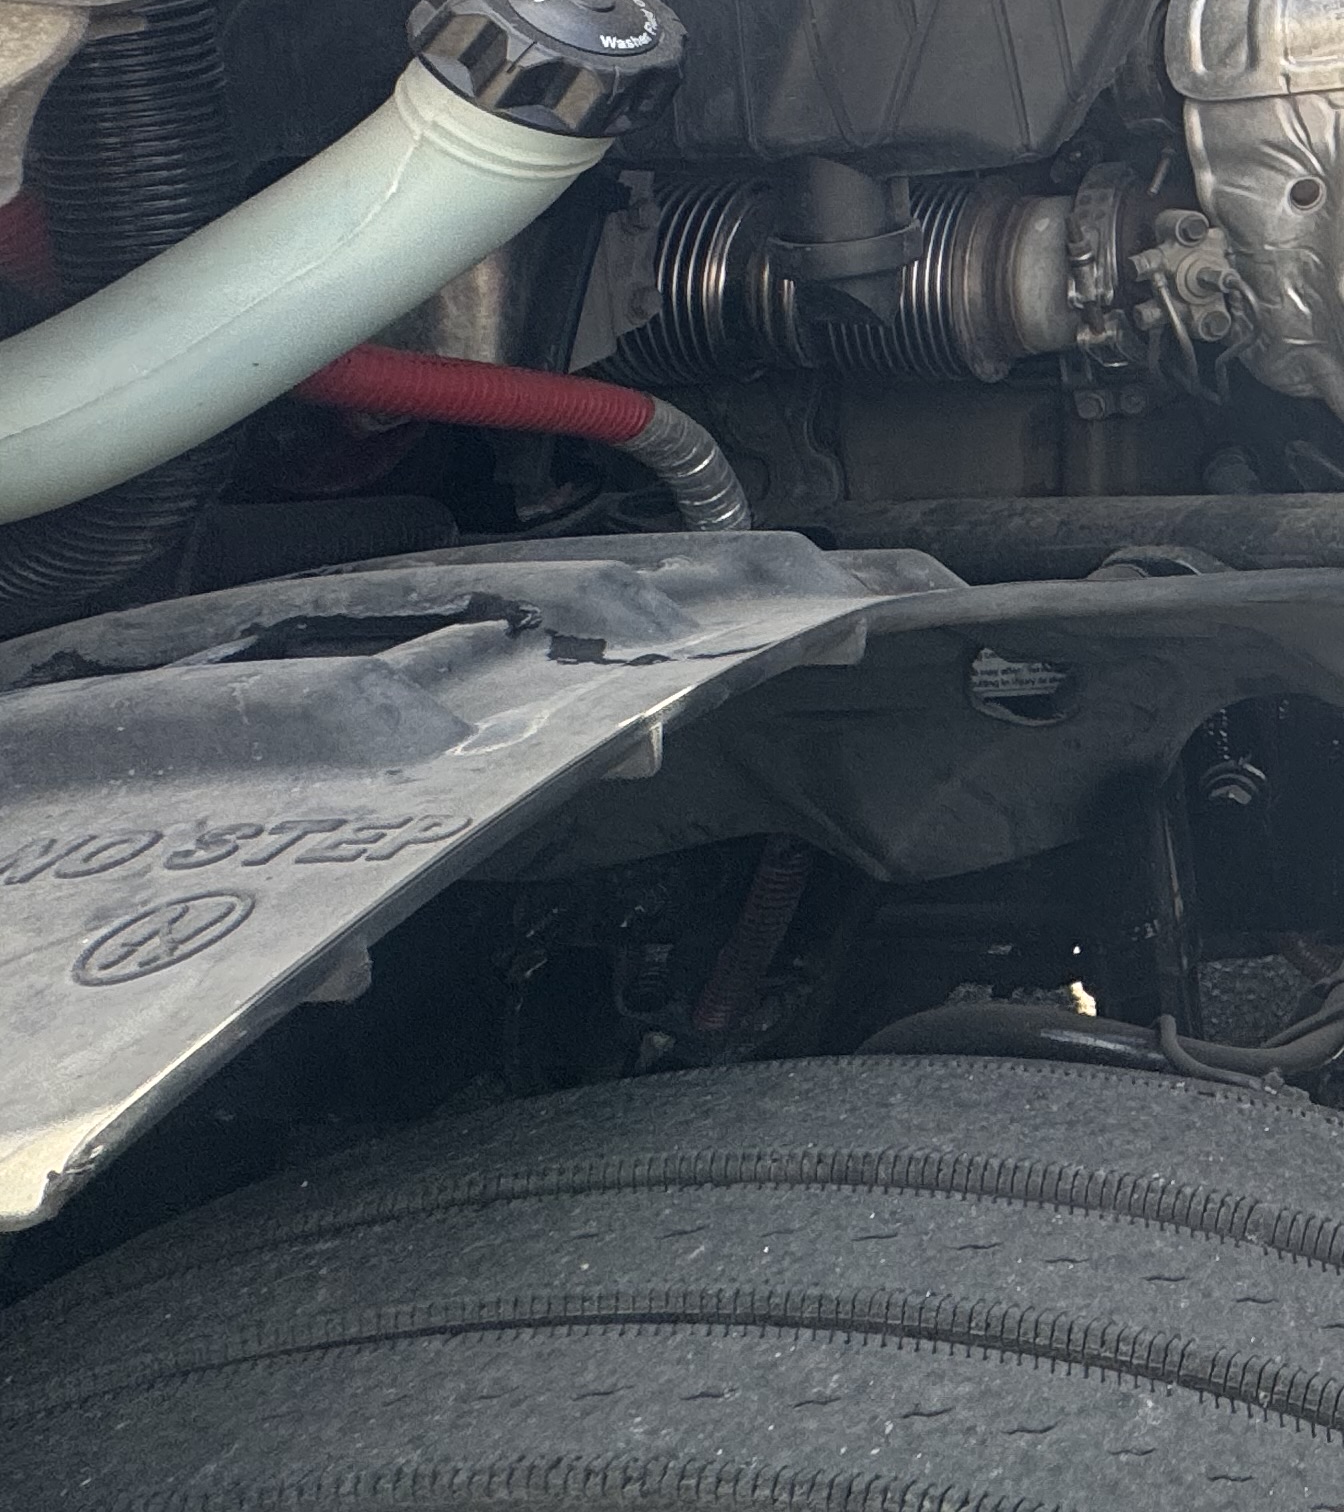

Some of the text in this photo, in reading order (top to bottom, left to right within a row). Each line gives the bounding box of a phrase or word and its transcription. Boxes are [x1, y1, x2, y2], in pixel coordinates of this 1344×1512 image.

[599, 32, 652, 49] Washer
[0, 815, 472, 885] NO STEP
